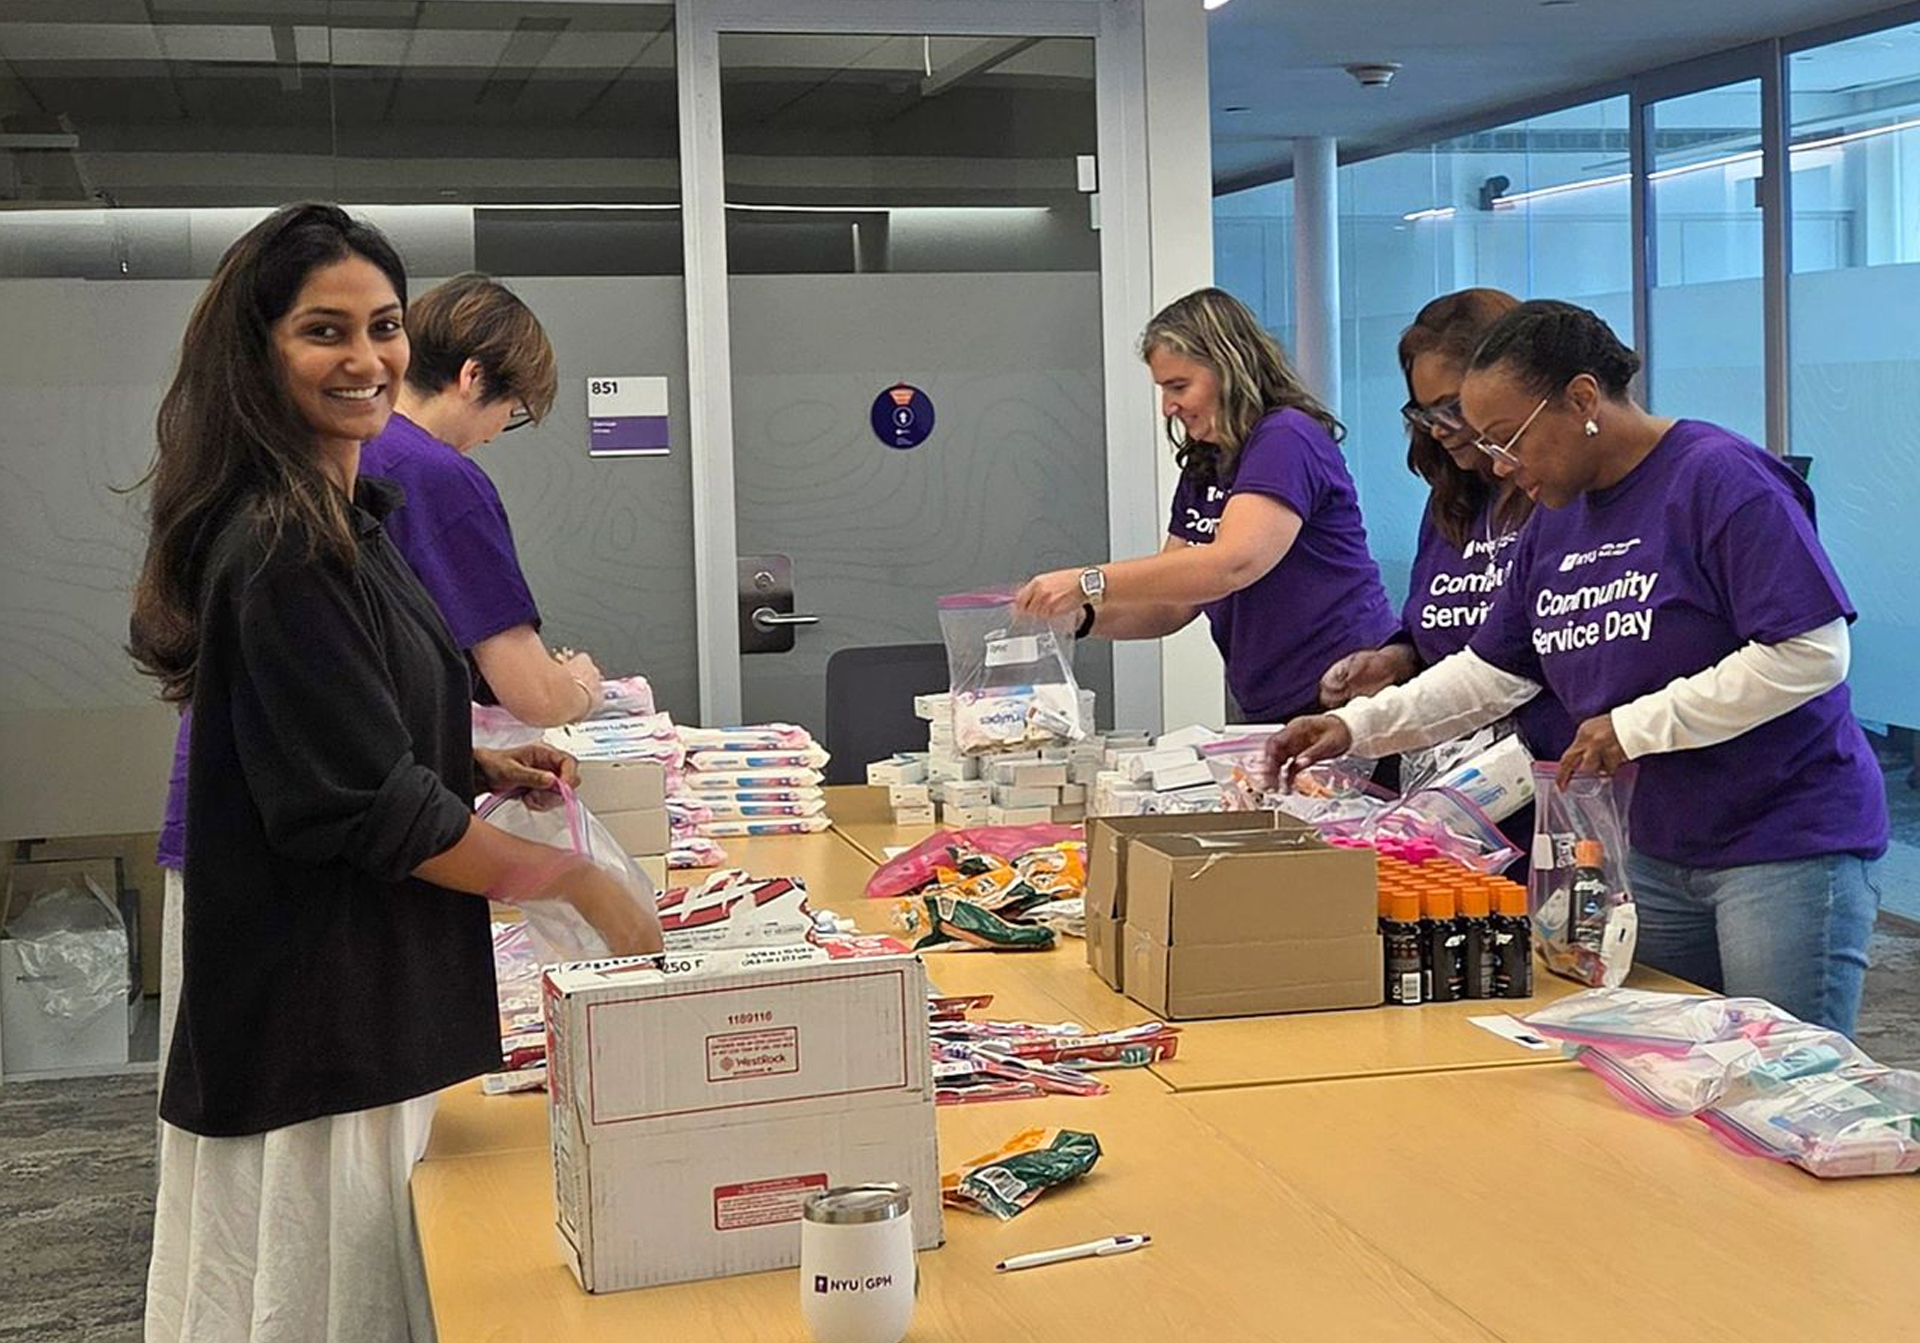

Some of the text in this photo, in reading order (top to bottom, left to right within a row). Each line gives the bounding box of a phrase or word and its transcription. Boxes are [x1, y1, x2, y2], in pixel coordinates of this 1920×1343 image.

[591, 381, 618, 395] 851
[1536, 570, 1658, 617] Community
[1421, 601, 1495, 629] Servi
[1605, 609, 1653, 641] Day
[662, 960, 692, 975] 250
[735, 1054, 786, 1067] WestRock
[830, 1275, 892, 1292] NYU GPH
